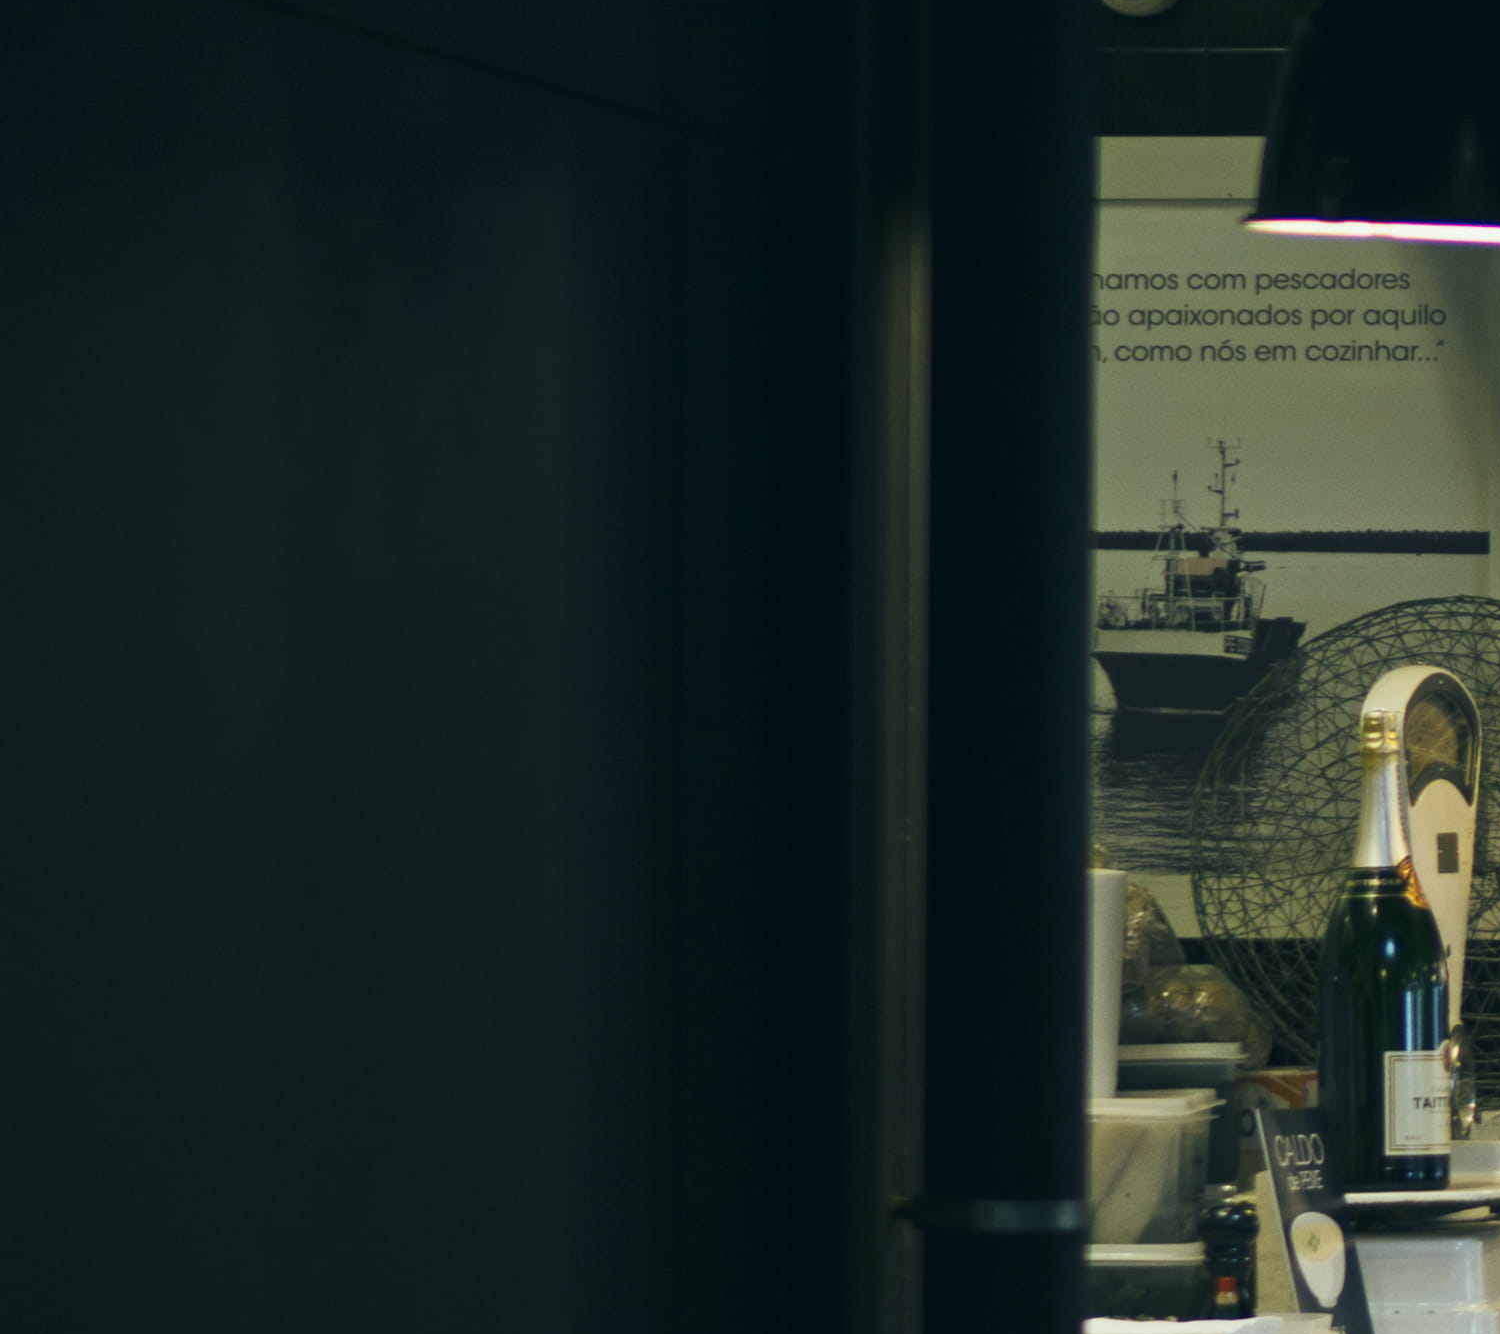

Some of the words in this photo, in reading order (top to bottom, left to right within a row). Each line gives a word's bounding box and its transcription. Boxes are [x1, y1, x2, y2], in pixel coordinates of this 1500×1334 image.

[1186, 273, 1247, 291] com
[1256, 268, 1411, 295] pescadores
[1128, 303, 1303, 331] apaixonados
[1311, 308, 1355, 331] por
[1363, 302, 1447, 331] aquilo
[1115, 344, 1193, 362] como
[1200, 340, 1247, 362] nós
[1254, 344, 1297, 362] em
[1274, 1132, 1325, 1167] CALDO
